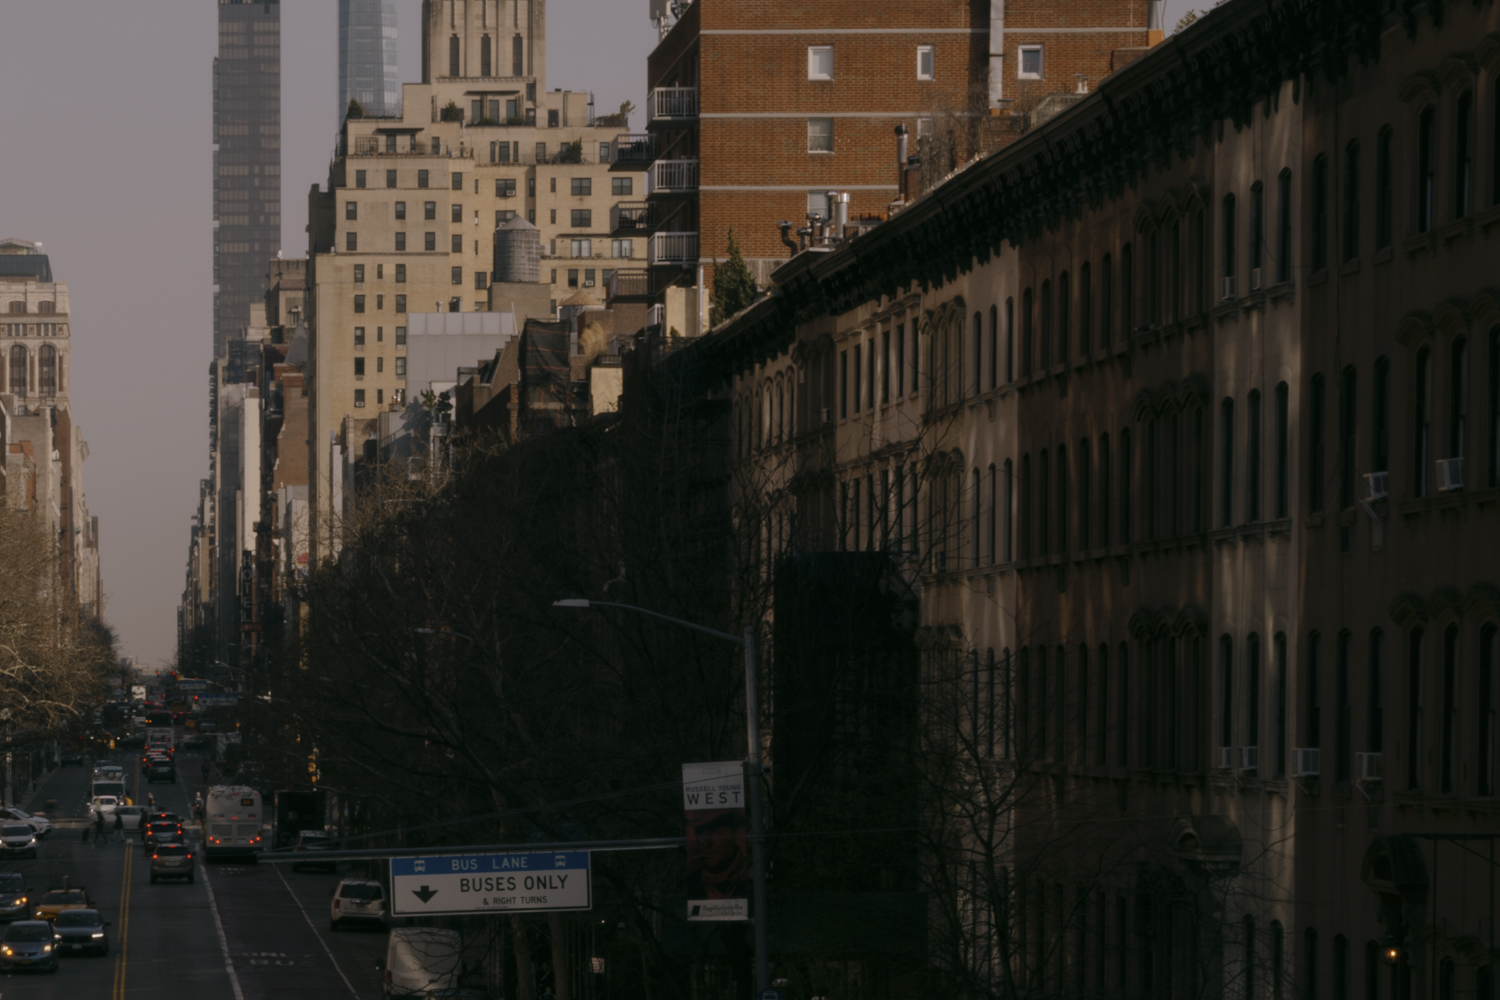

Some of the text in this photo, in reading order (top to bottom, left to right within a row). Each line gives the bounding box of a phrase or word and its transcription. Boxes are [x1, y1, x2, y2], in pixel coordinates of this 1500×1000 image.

[243, 555, 251, 622] HOTEL
[687, 791, 740, 805] WEST
[451, 857, 528, 871] BUS LANE
[460, 875, 568, 892] BUSES ONLY
[493, 897, 516, 905] RIGHT
[520, 896, 547, 904] TURNS
